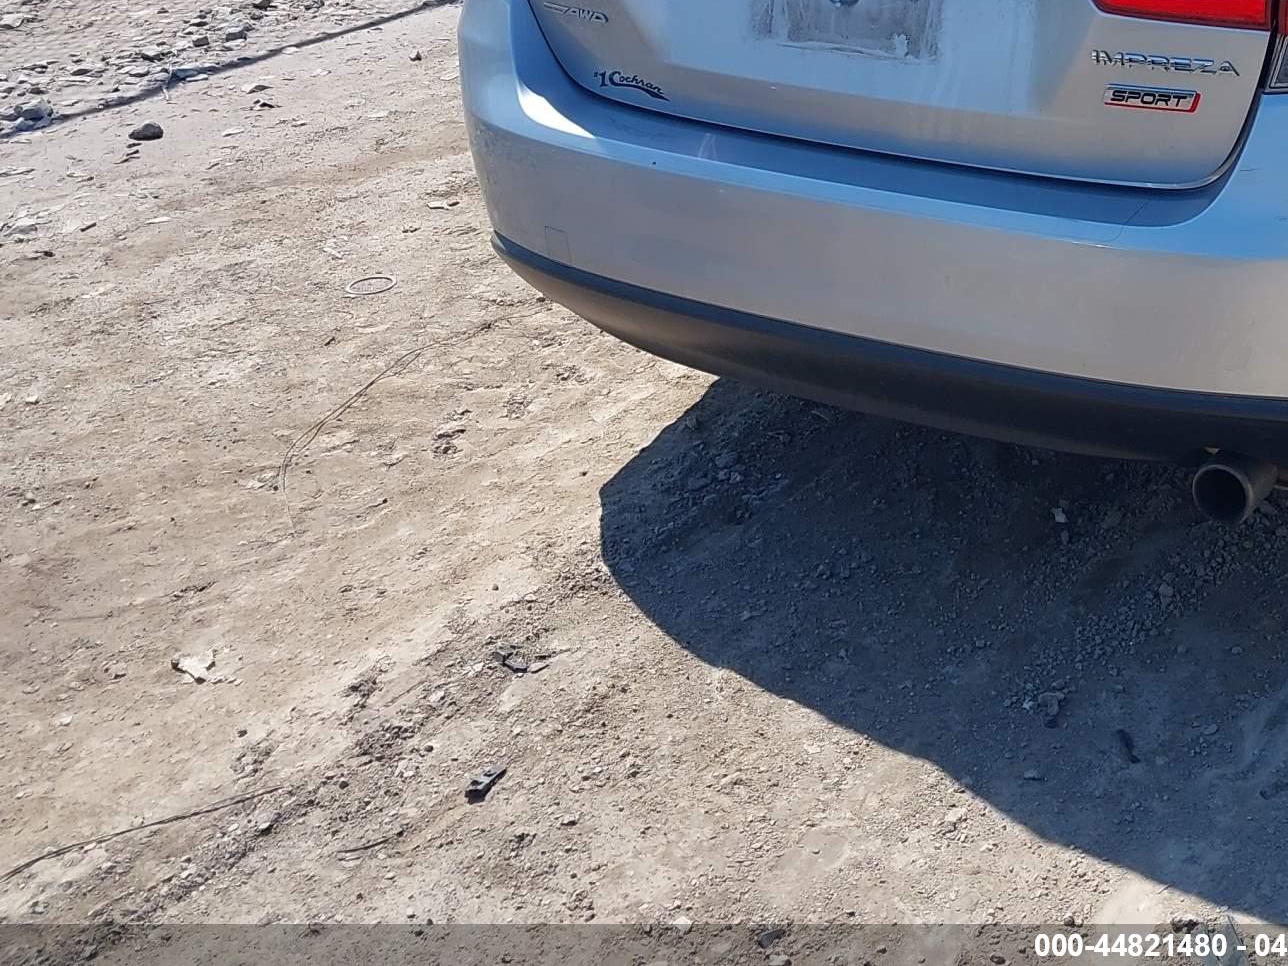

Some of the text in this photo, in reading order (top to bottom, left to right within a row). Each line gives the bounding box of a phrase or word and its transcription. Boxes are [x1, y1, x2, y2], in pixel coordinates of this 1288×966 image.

[563, 6, 608, 24] AWD
[1091, 49, 1240, 76] IMPREZA
[609, 70, 666, 96] Cochran
[1110, 89, 1188, 108] SPORT
